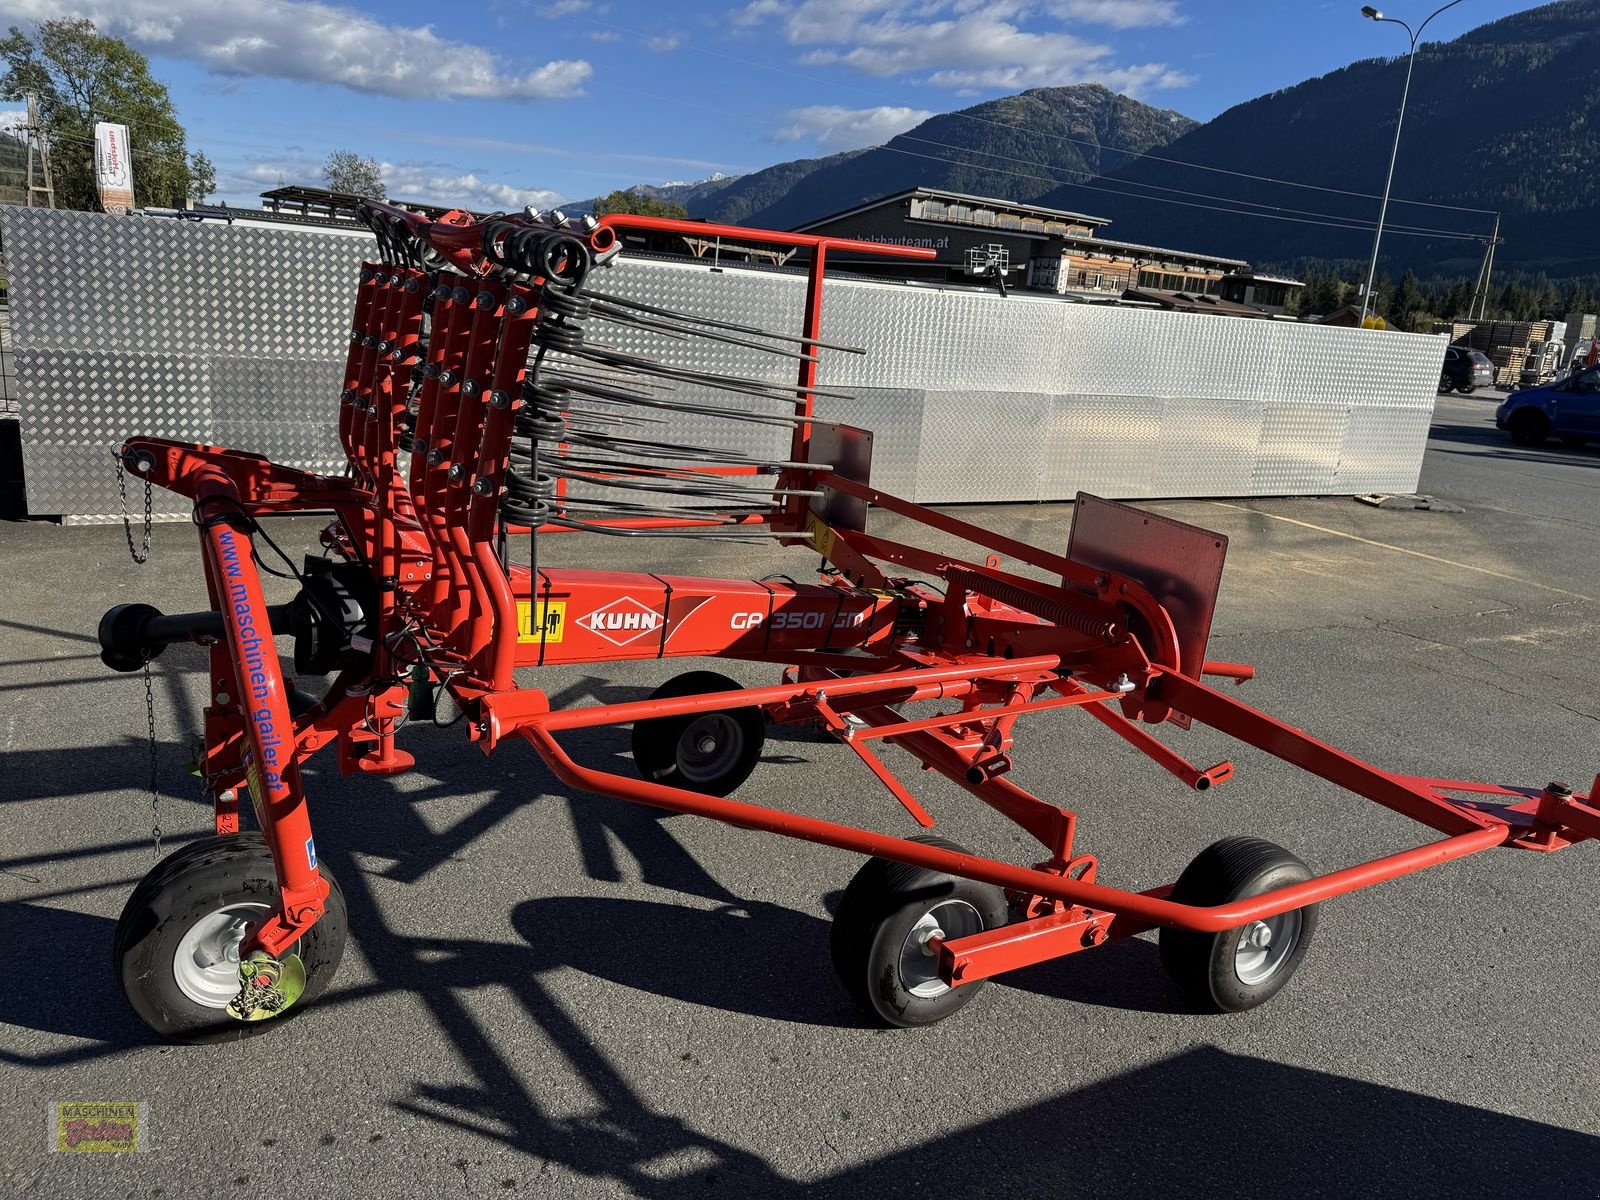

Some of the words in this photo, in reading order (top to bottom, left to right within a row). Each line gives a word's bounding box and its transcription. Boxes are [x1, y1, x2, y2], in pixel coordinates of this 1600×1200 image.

[590, 612, 657, 630] KUHN
[730, 612, 764, 629] GA
[770, 612, 825, 629] 3501
[219, 531, 284, 790] www.maschinen-gailer.at
